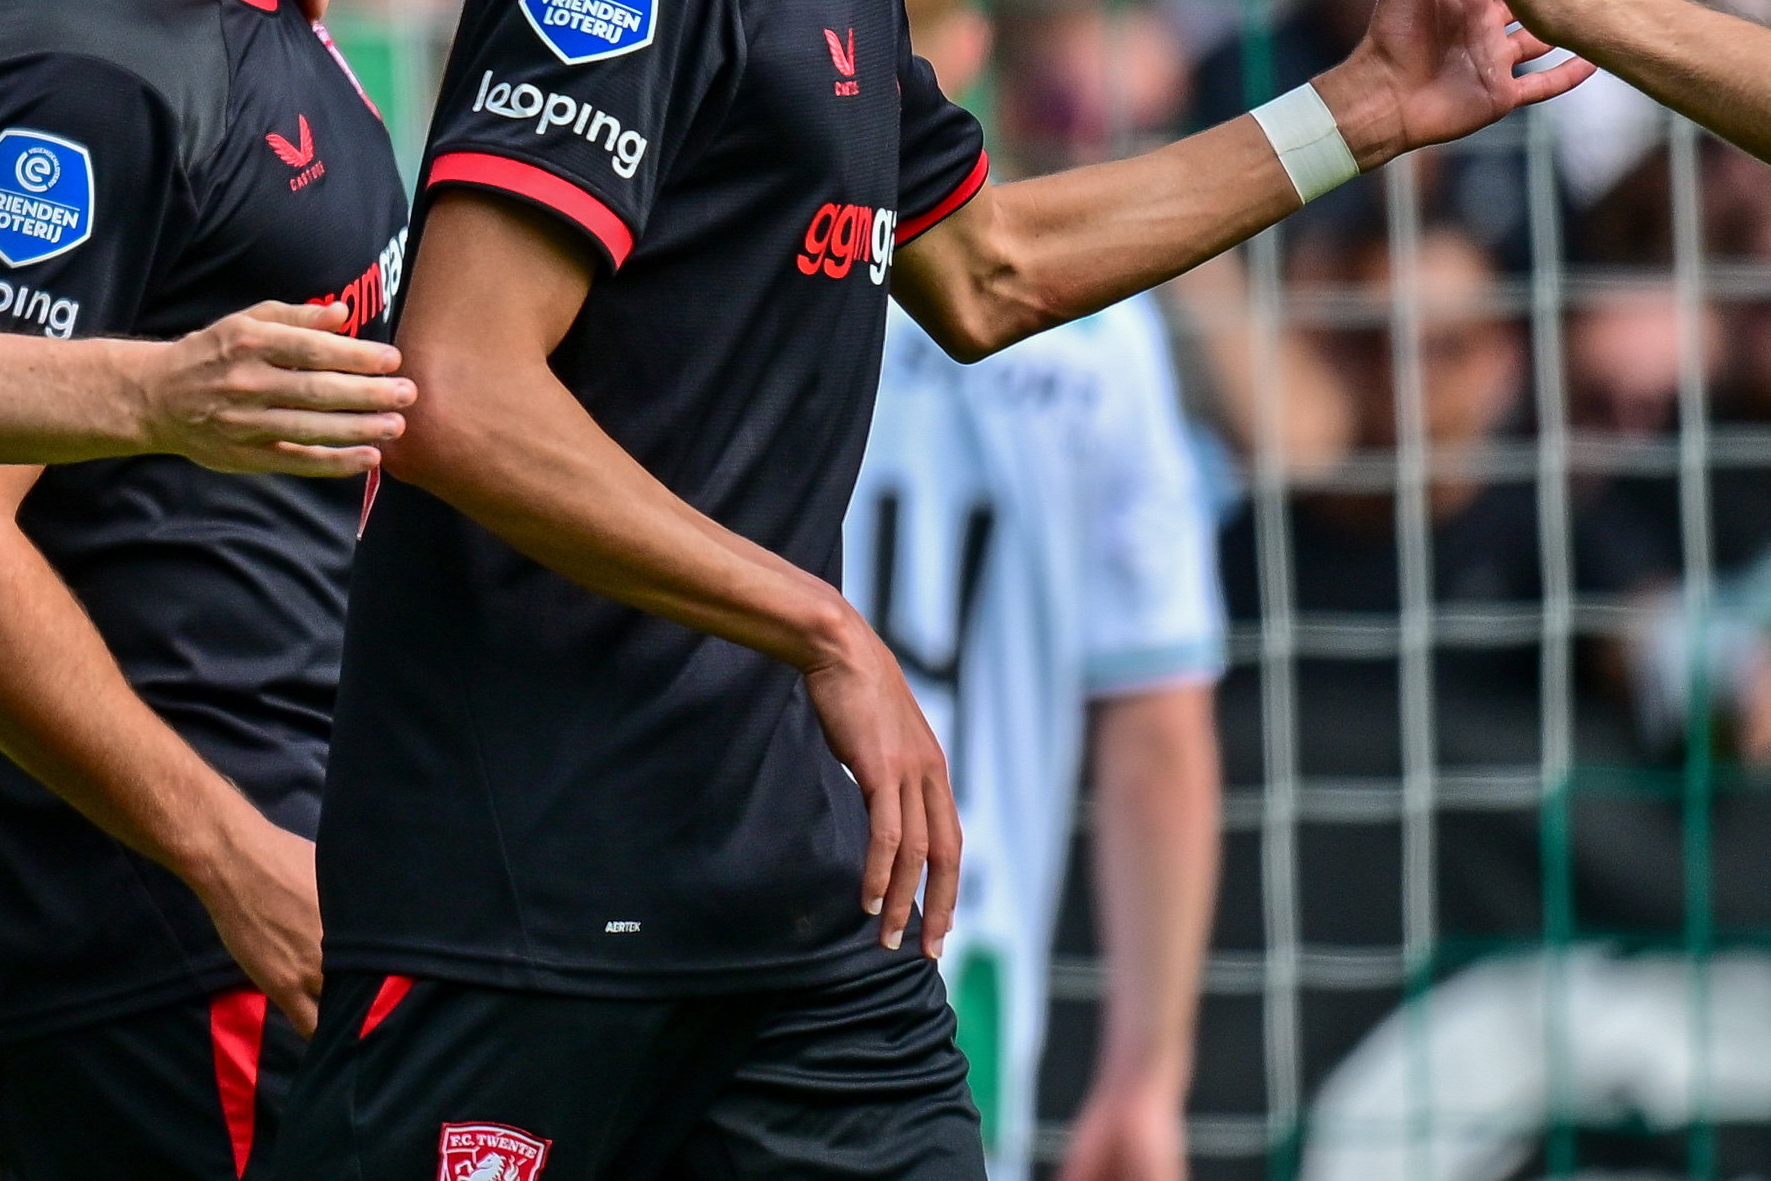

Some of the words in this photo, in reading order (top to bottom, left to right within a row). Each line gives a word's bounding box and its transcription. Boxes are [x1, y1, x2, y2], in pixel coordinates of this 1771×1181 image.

[543, 6, 624, 44] LOTERIJ
[472, 69, 648, 180] looping
[476, 1133, 538, 1159] TWENTE
